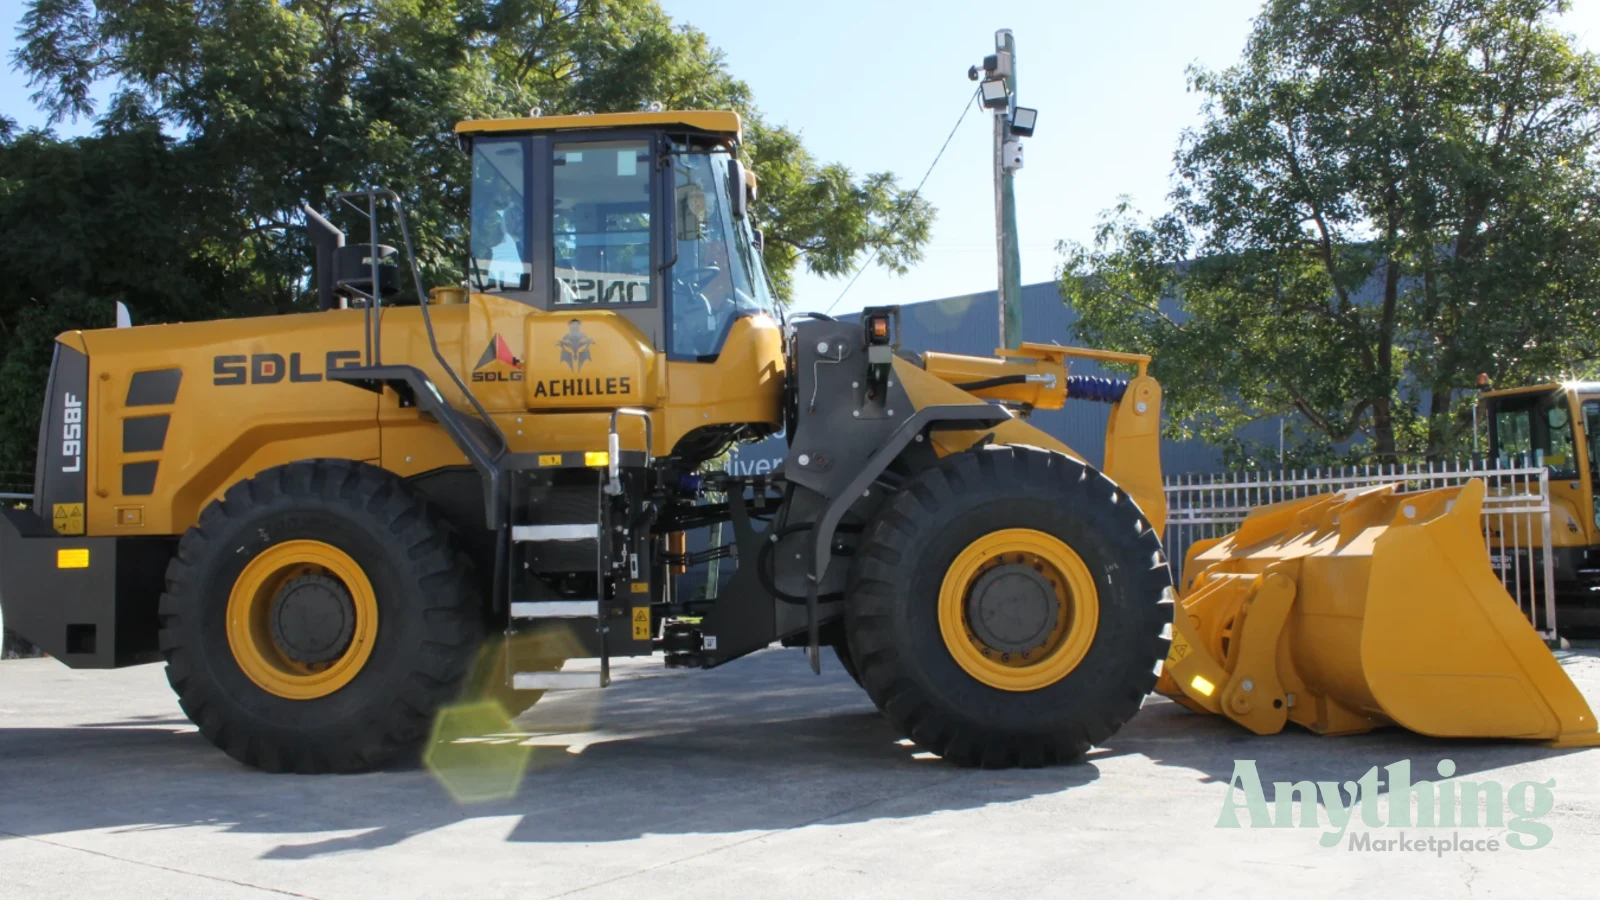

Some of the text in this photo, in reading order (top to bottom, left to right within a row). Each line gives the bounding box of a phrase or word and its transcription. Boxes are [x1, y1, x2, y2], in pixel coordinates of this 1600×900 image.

[213, 351, 361, 386] SDLG
[472, 371, 523, 382] SDLG
[534, 377, 631, 398] ACHILLES
[62, 392, 82, 472] L958F
